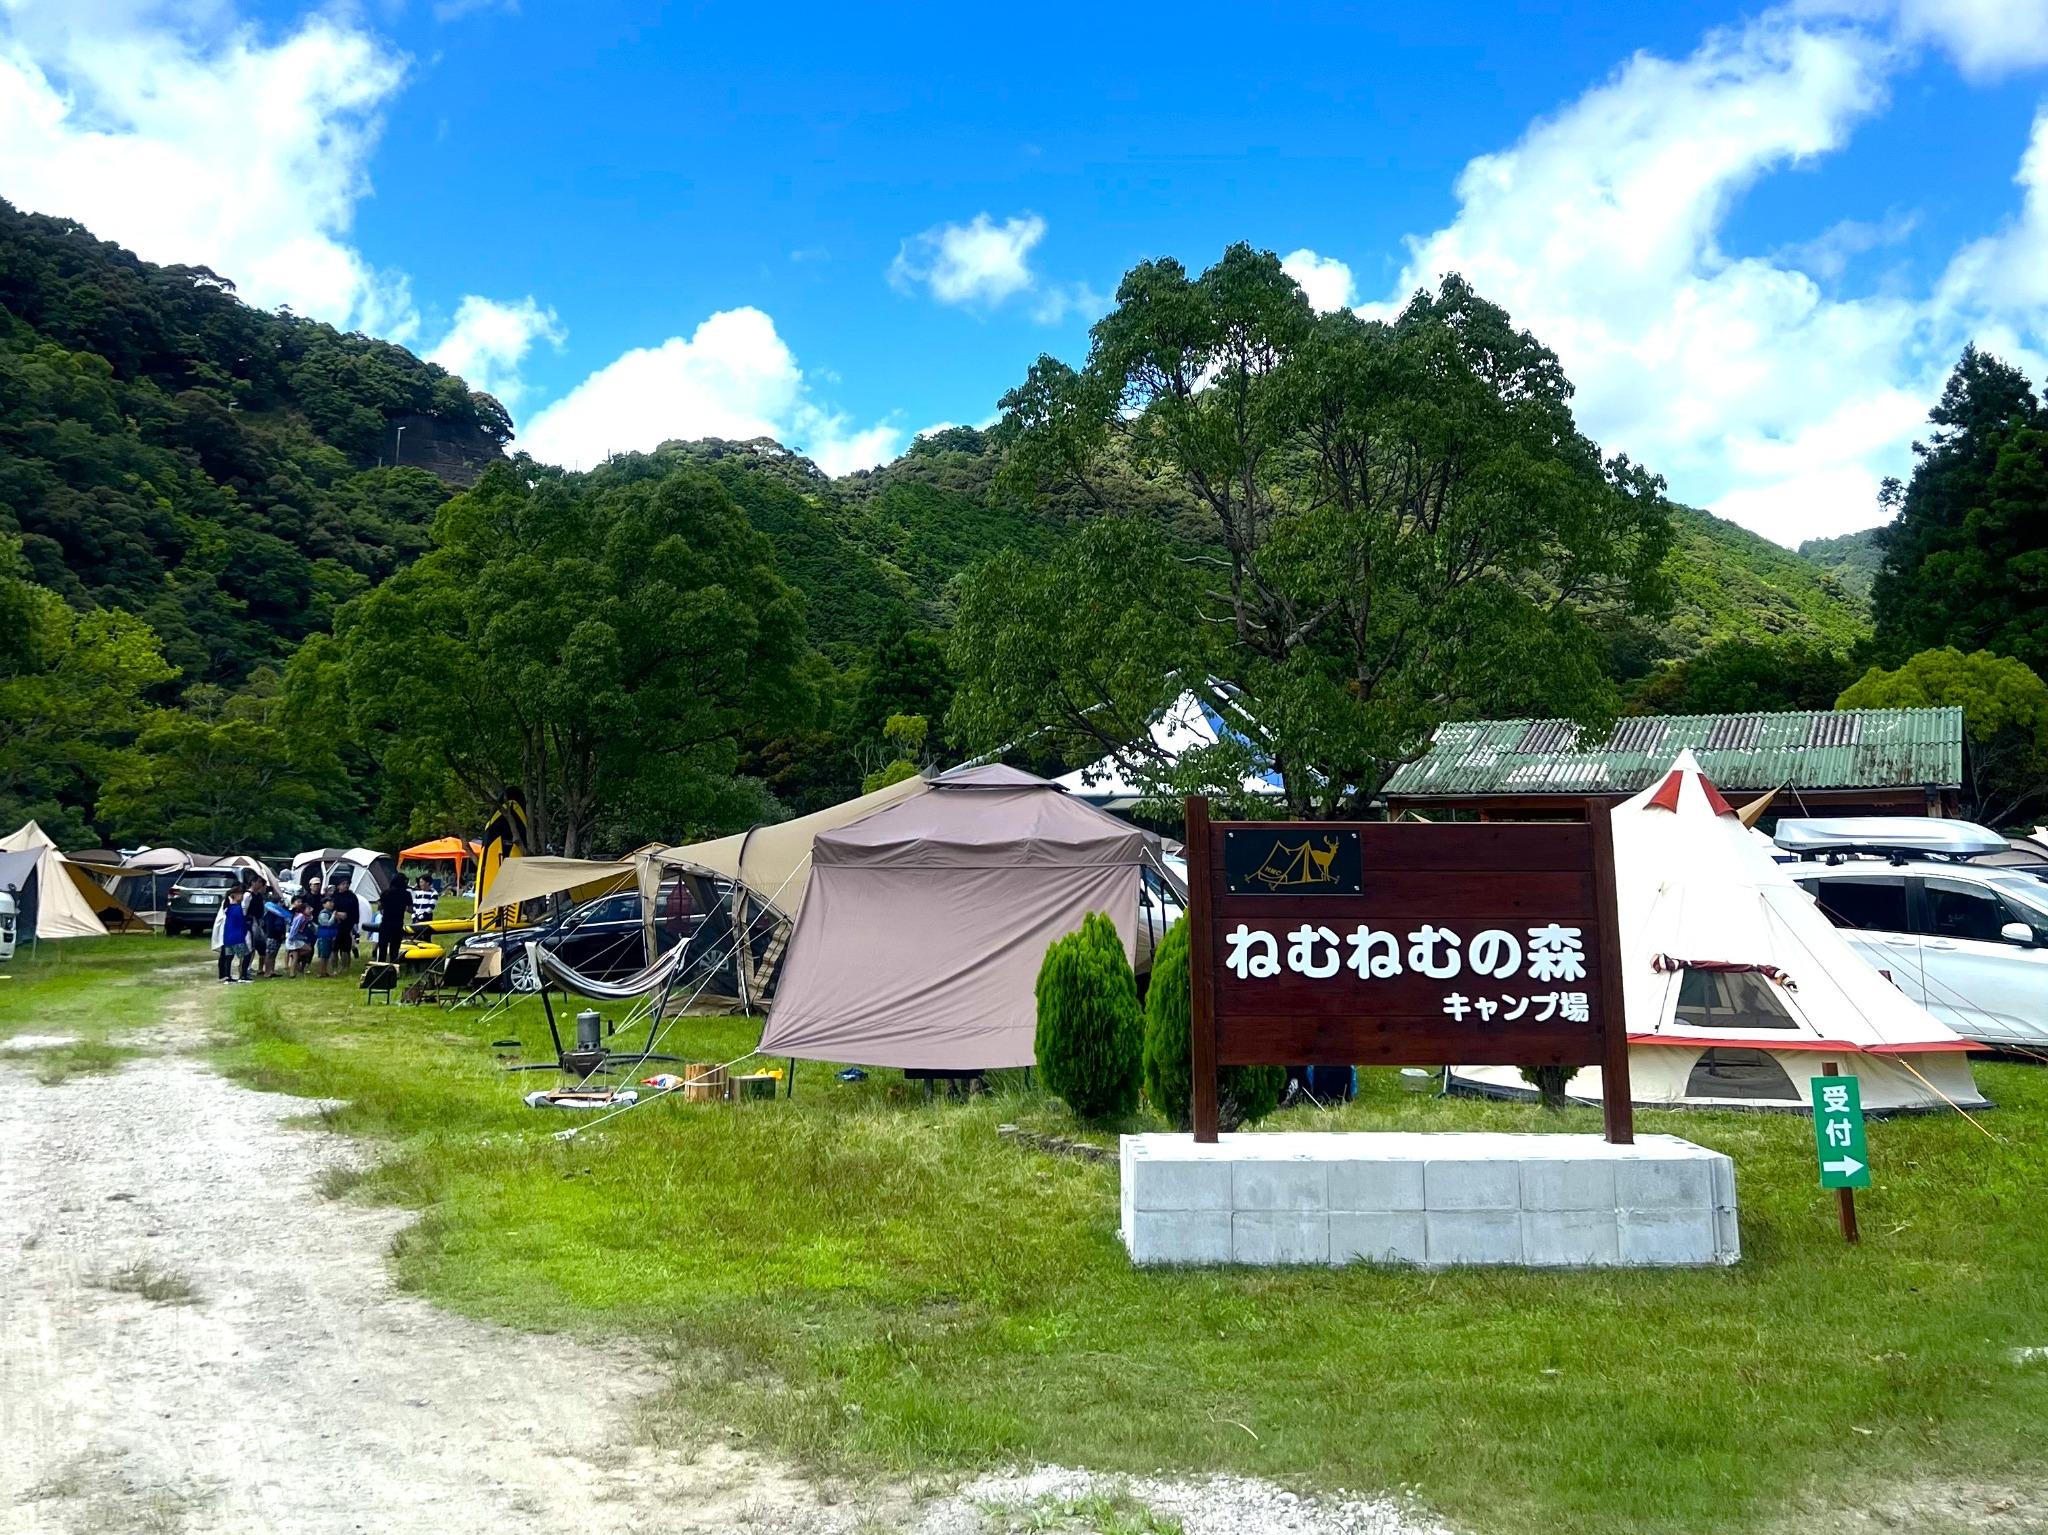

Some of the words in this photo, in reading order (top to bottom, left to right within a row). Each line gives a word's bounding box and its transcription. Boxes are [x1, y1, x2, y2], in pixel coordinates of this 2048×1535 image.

[1225, 923, 1587, 982] ねむねむの森
[1442, 991, 1590, 1023] キャンプ場
[1822, 1085, 1852, 1147] 受付
